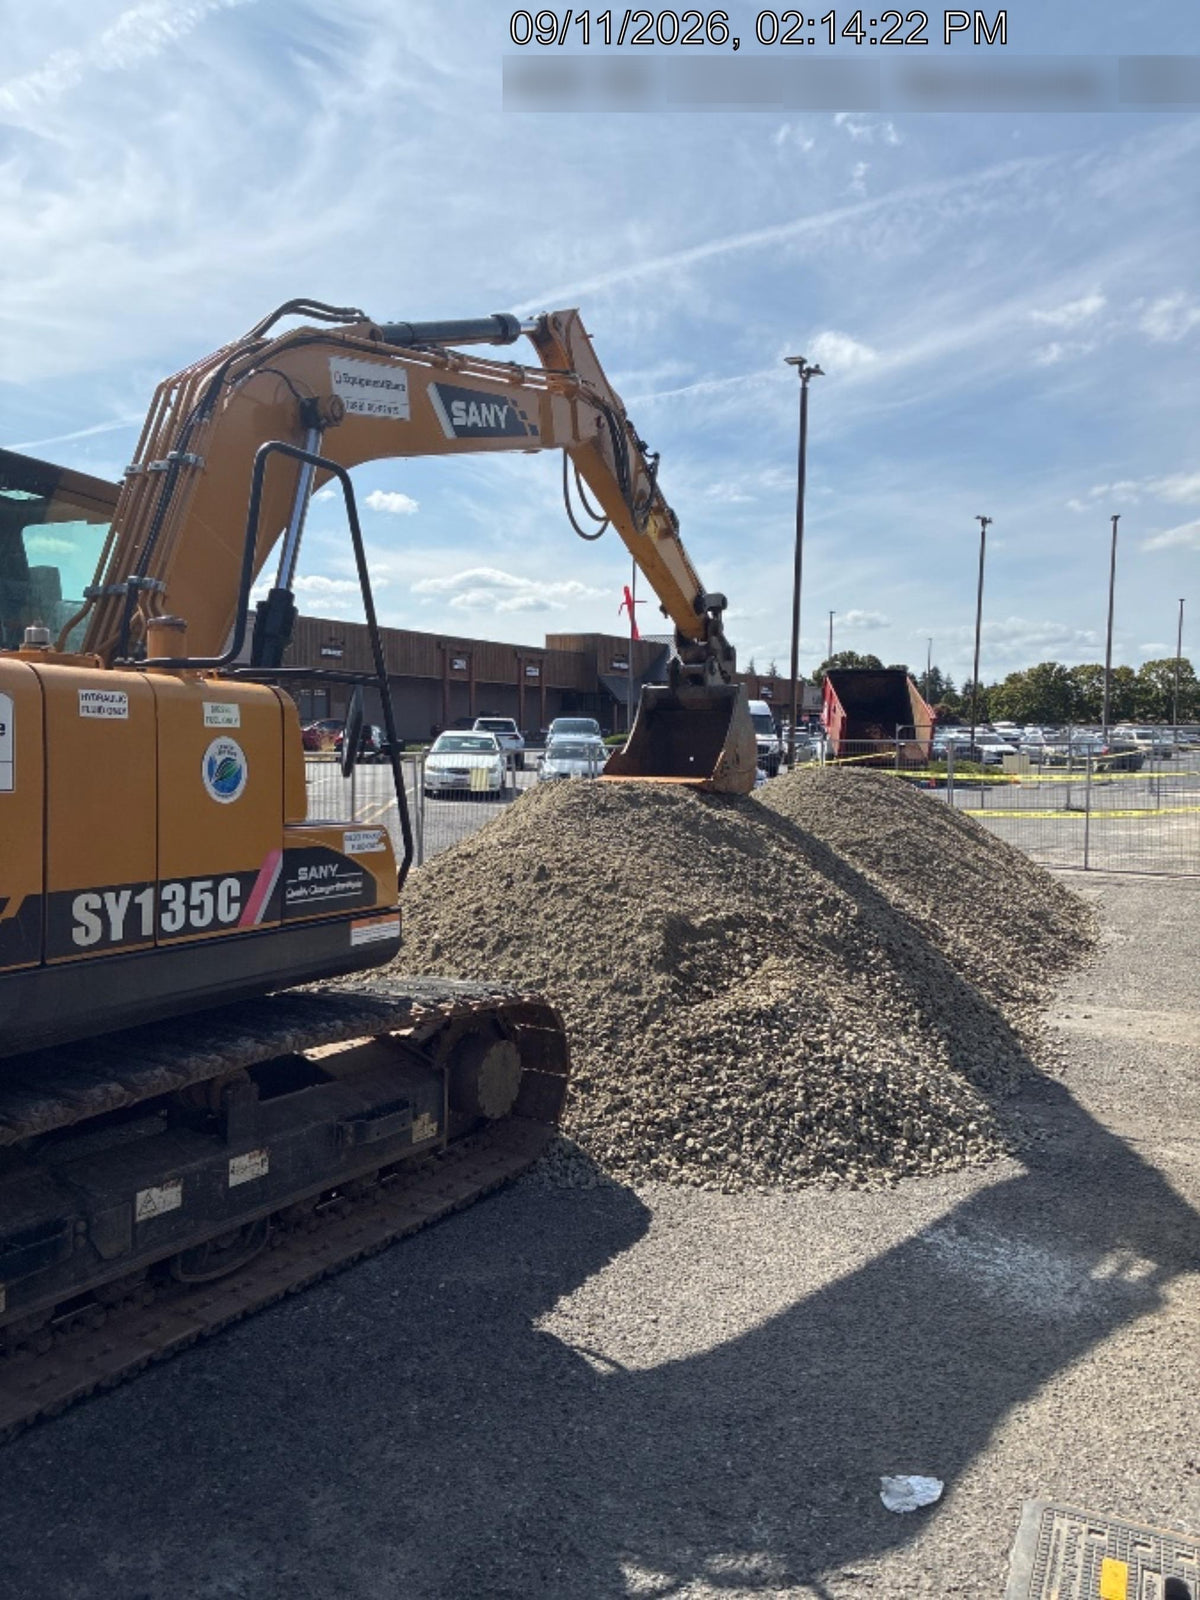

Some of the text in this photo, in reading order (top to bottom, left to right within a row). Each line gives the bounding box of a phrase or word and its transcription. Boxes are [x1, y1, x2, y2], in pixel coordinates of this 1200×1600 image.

[451, 400, 509, 429] SANY
[298, 863, 339, 881] SANY
[72, 877, 241, 947] SY135C
